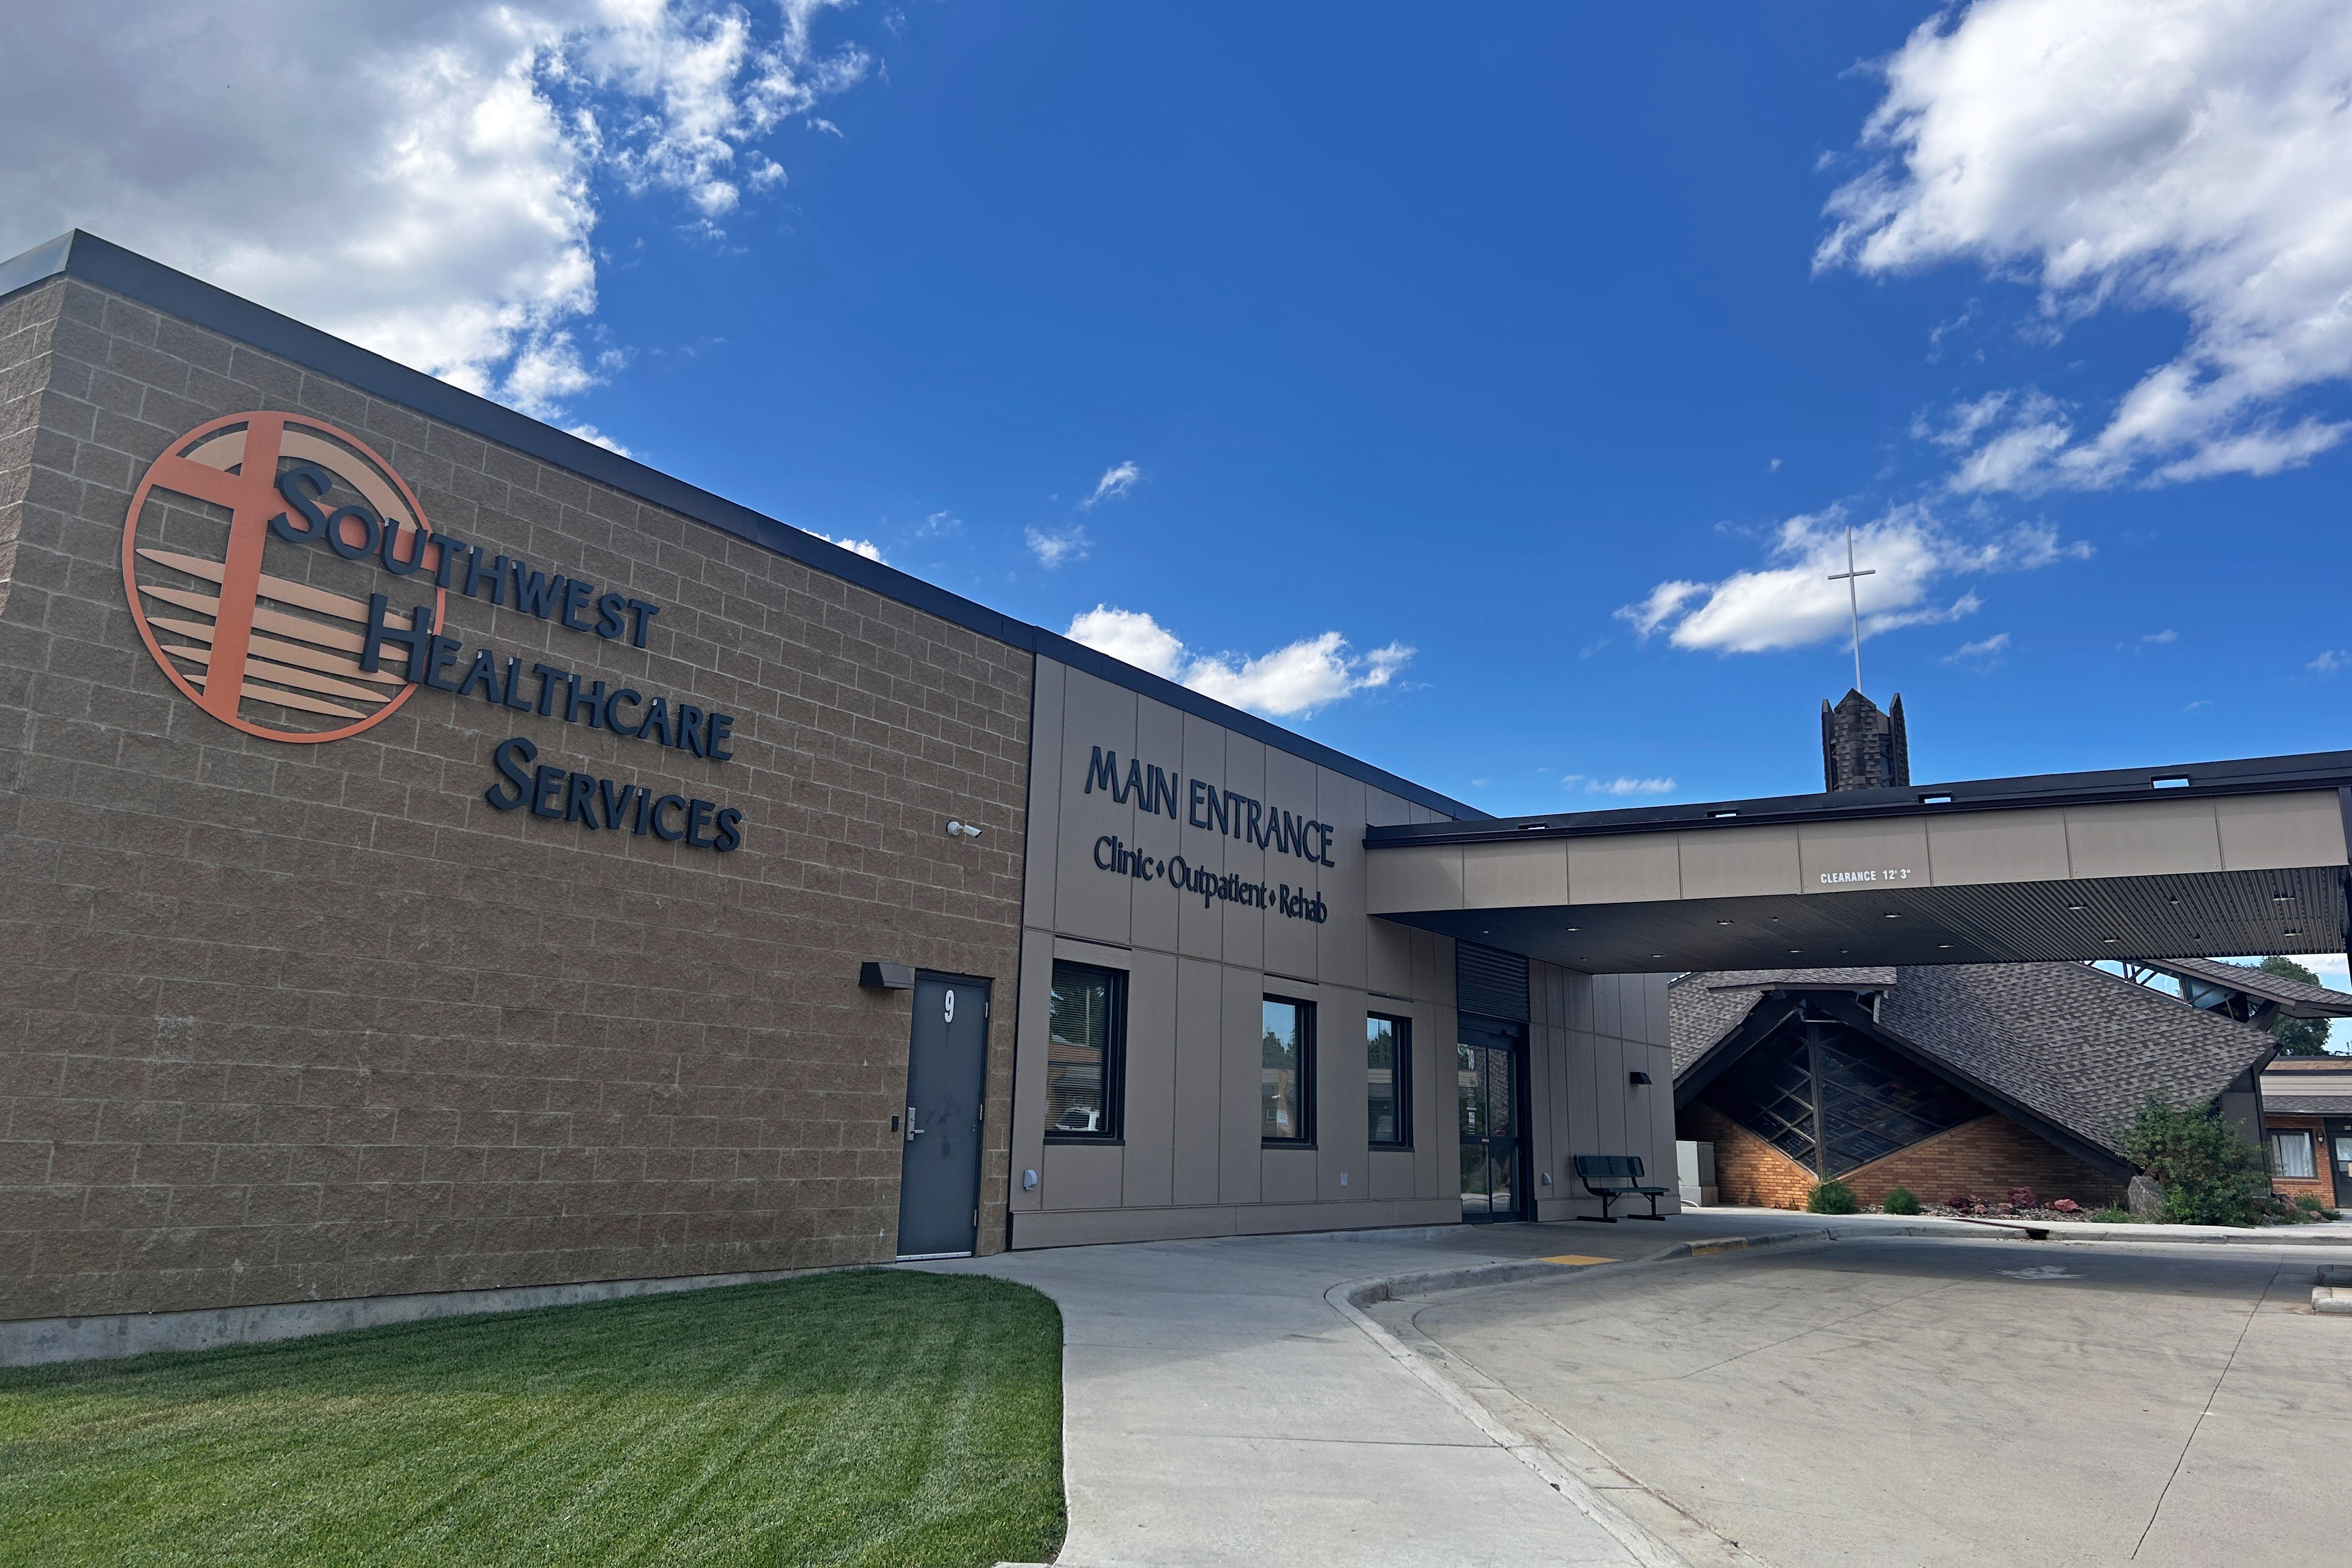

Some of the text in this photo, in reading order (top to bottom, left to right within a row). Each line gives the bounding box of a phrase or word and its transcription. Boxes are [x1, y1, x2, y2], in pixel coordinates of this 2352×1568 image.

[268, 467, 660, 649] SOUTHWEST
[359, 593, 734, 761] HEALTHCARE
[486, 737, 742, 852] SERVICES
[1084, 746, 1335, 867] MAIN ENTRANCE
[1094, 836, 1328, 923] Clinic Outpatient Rehab
[1821, 870, 1877, 884] CLEARANCE
[944, 989, 954, 1023] 9
